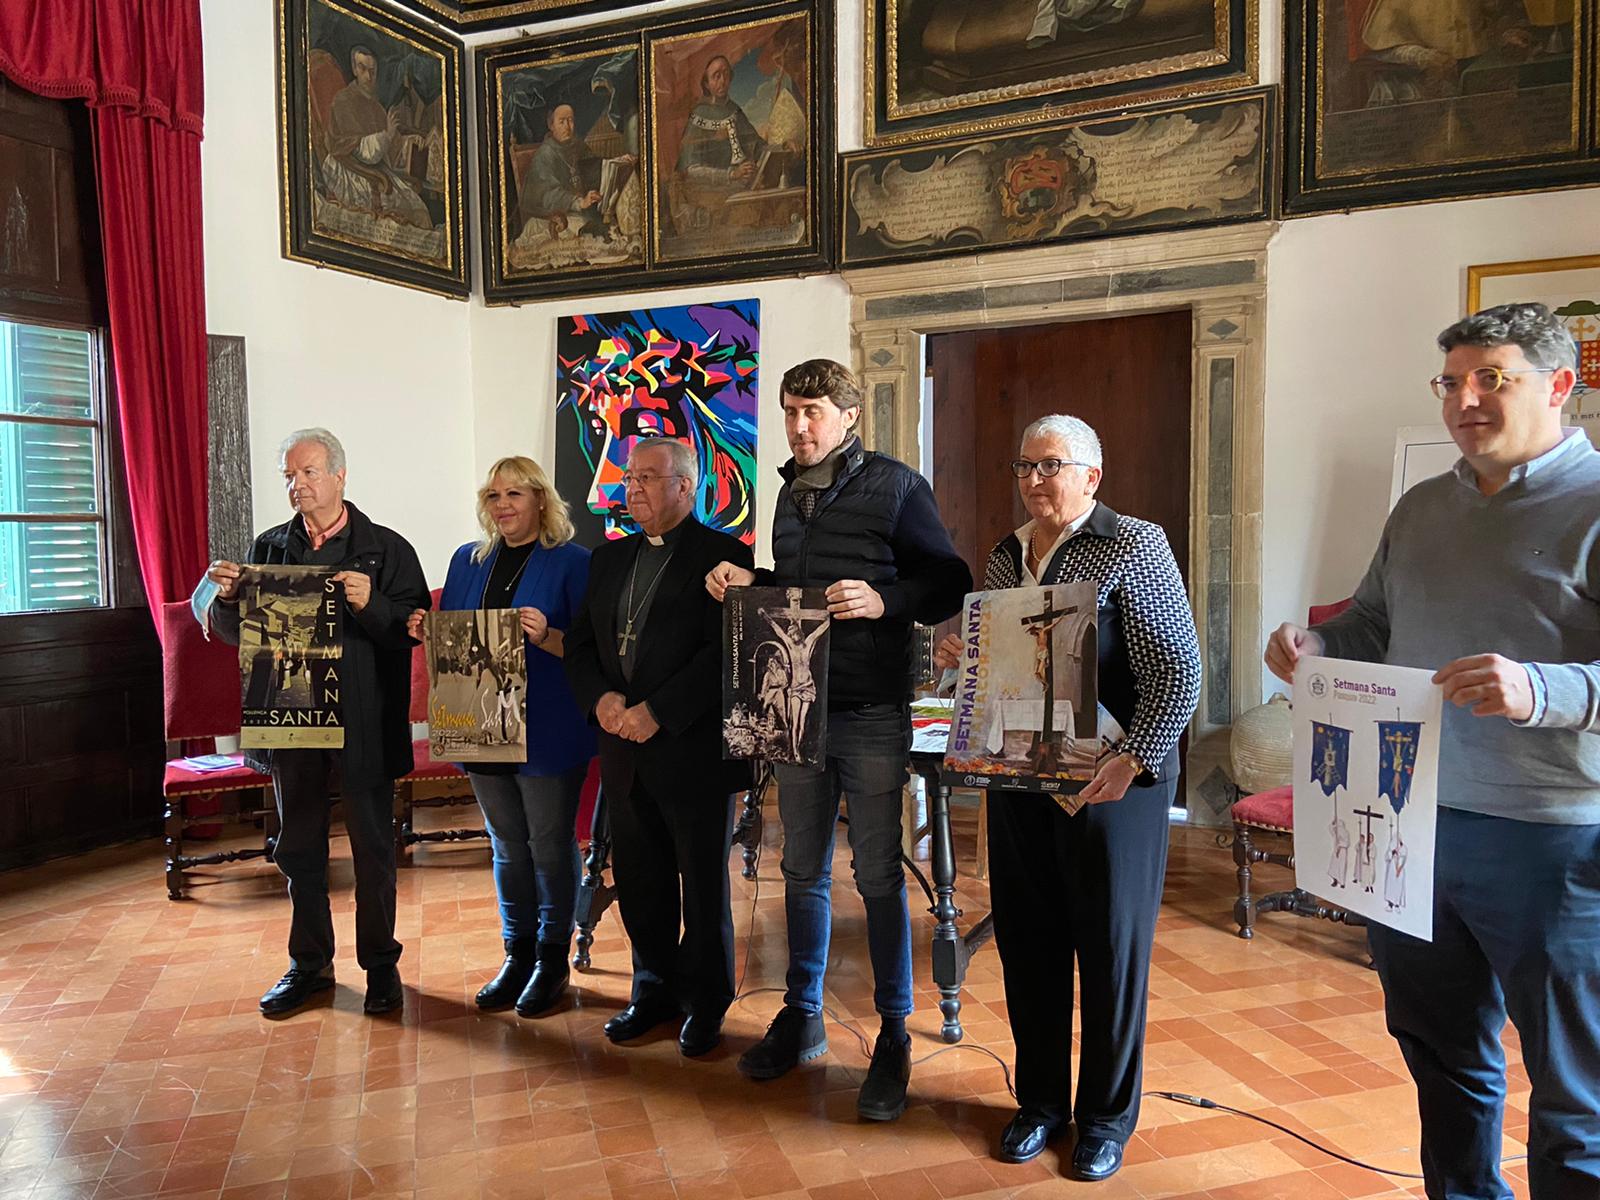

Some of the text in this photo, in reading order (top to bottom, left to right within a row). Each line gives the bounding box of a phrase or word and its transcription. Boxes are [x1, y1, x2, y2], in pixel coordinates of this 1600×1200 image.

[954, 599, 982, 752] SETMANA SANTA
[1333, 678, 1397, 697] Setmana Santa
[269, 709, 339, 725] SANTA
[431, 729, 458, 737] 2022
